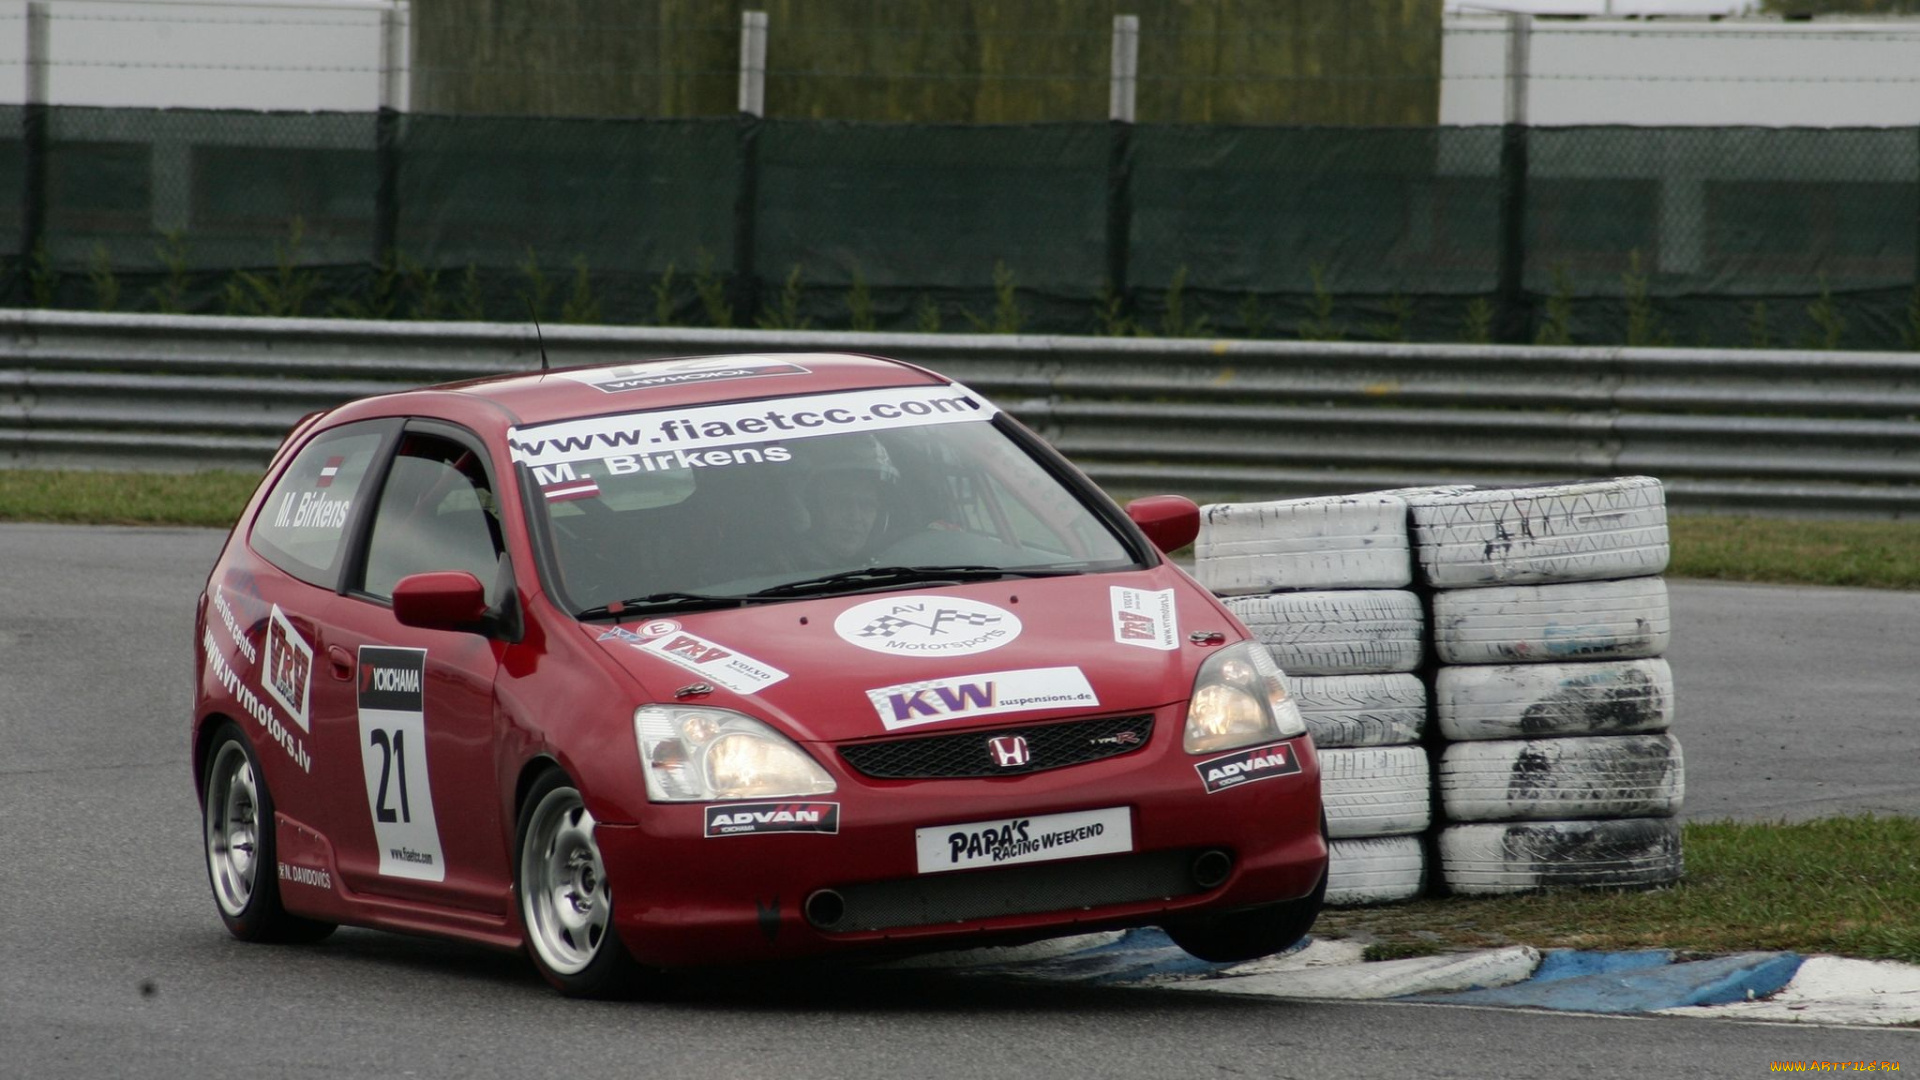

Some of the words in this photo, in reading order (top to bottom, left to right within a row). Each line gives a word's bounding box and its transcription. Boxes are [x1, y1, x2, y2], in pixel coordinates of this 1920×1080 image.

[606, 369, 754, 388] YOKOHAMA
[509, 396, 980, 456] www.fiaetcc.com
[532, 463, 591, 486] M.
[608, 444, 791, 476] Birkens
[275, 493, 290, 527] M.
[293, 492, 349, 528] Birkens
[892, 603, 924, 615] AV
[661, 636, 732, 664] VRV
[886, 628, 1007, 650] Motorsports
[373, 667, 420, 692] YOKOHAMA
[731, 660, 771, 679] VOLVO
[203, 625, 311, 774] www.vrvmotors.lv
[887, 681, 996, 721] KW
[1000, 692, 1092, 706] suspensions.de
[371, 728, 410, 823] 21
[1208, 753, 1286, 782] ADVAN
[710, 811, 819, 826] ADVAN
[948, 819, 1030, 863] PAPA'S
[992, 838, 1041, 862] RACING
[1041, 822, 1105, 850] WEEKEND
